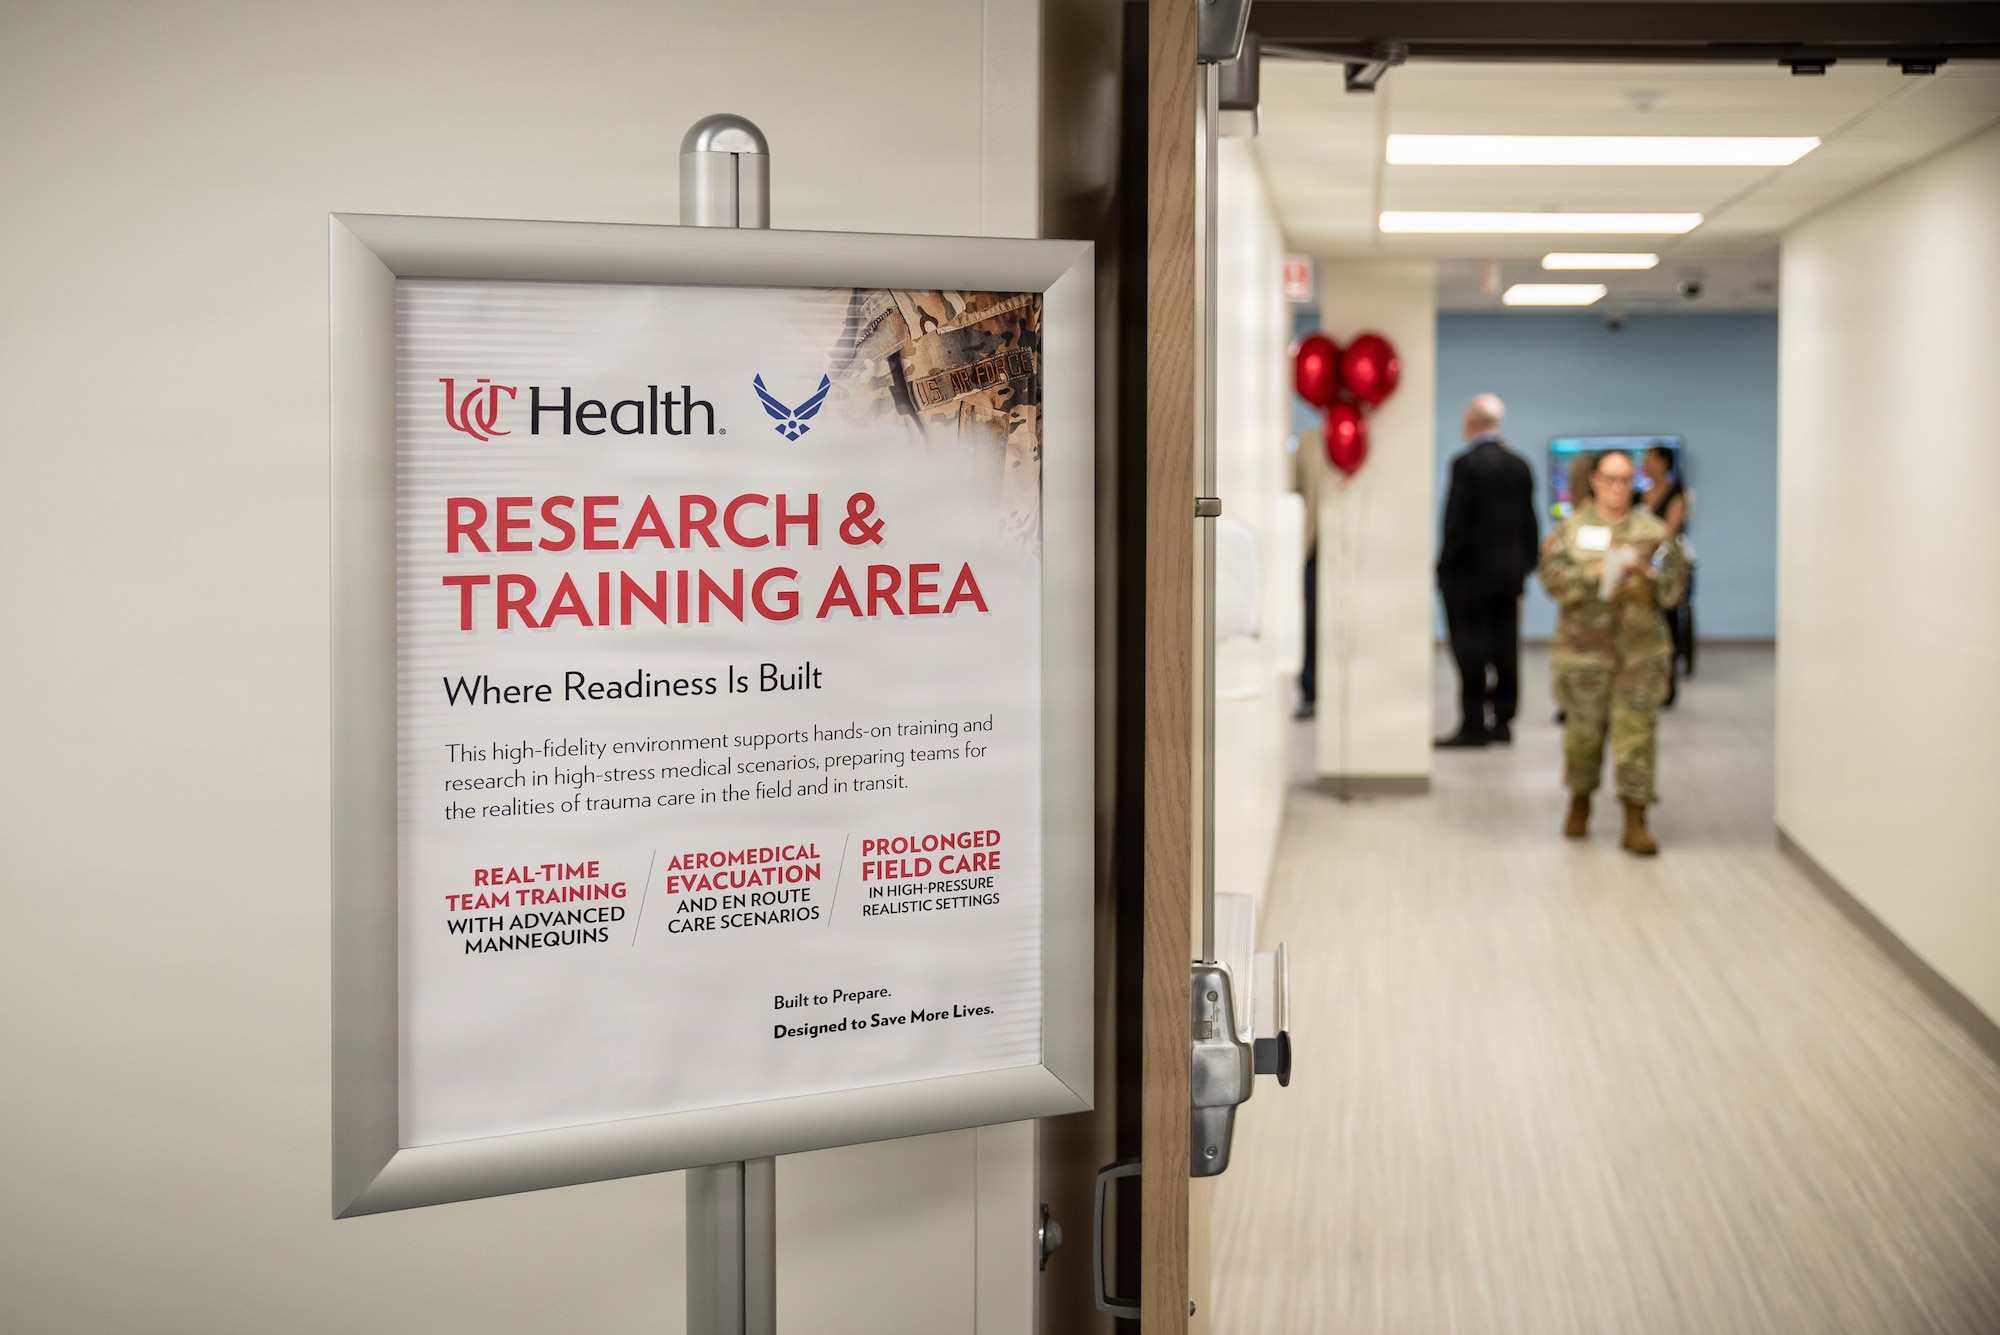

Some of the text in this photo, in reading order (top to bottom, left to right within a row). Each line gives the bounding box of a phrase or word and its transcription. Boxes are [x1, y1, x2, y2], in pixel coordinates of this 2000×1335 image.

[949, 369, 973, 395] AIR
[975, 352, 1033, 389] FORCE
[447, 492, 885, 553] RESEARCH &
[442, 562, 989, 631] TRAINING AREA
[443, 661, 822, 706] Where Readiness Is Built
[445, 714, 992, 764] This high-fidelity environment supports hands-on training and
[446, 741, 987, 791] research in high-stress medical scenarios, preparing teams for
[445, 774, 908, 820] the realities of trauma care in the field and in transit.
[668, 843, 820, 871] AEROMEDICAL
[863, 830, 1000, 856] PROLONGED
[475, 861, 599, 886] REAL-TIME
[667, 863, 820, 894] EVACUATION
[863, 851, 1000, 881] FIELD CARE
[445, 882, 626, 911] TEAM TRAINING
[677, 888, 810, 913] AND EN ROUTE
[870, 877, 993, 898] IN HIGH-PRESSURE
[863, 893, 999, 916] REALISTIC SETTINGS
[447, 906, 625, 935] WITH ADVANCED
[668, 906, 819, 933] CARE SCENARIOS
[465, 927, 608, 954] MANNEQUINS
[775, 989, 891, 1009] Built to Prepare.
[774, 1005, 994, 1039] Designed to Save More Lives.
